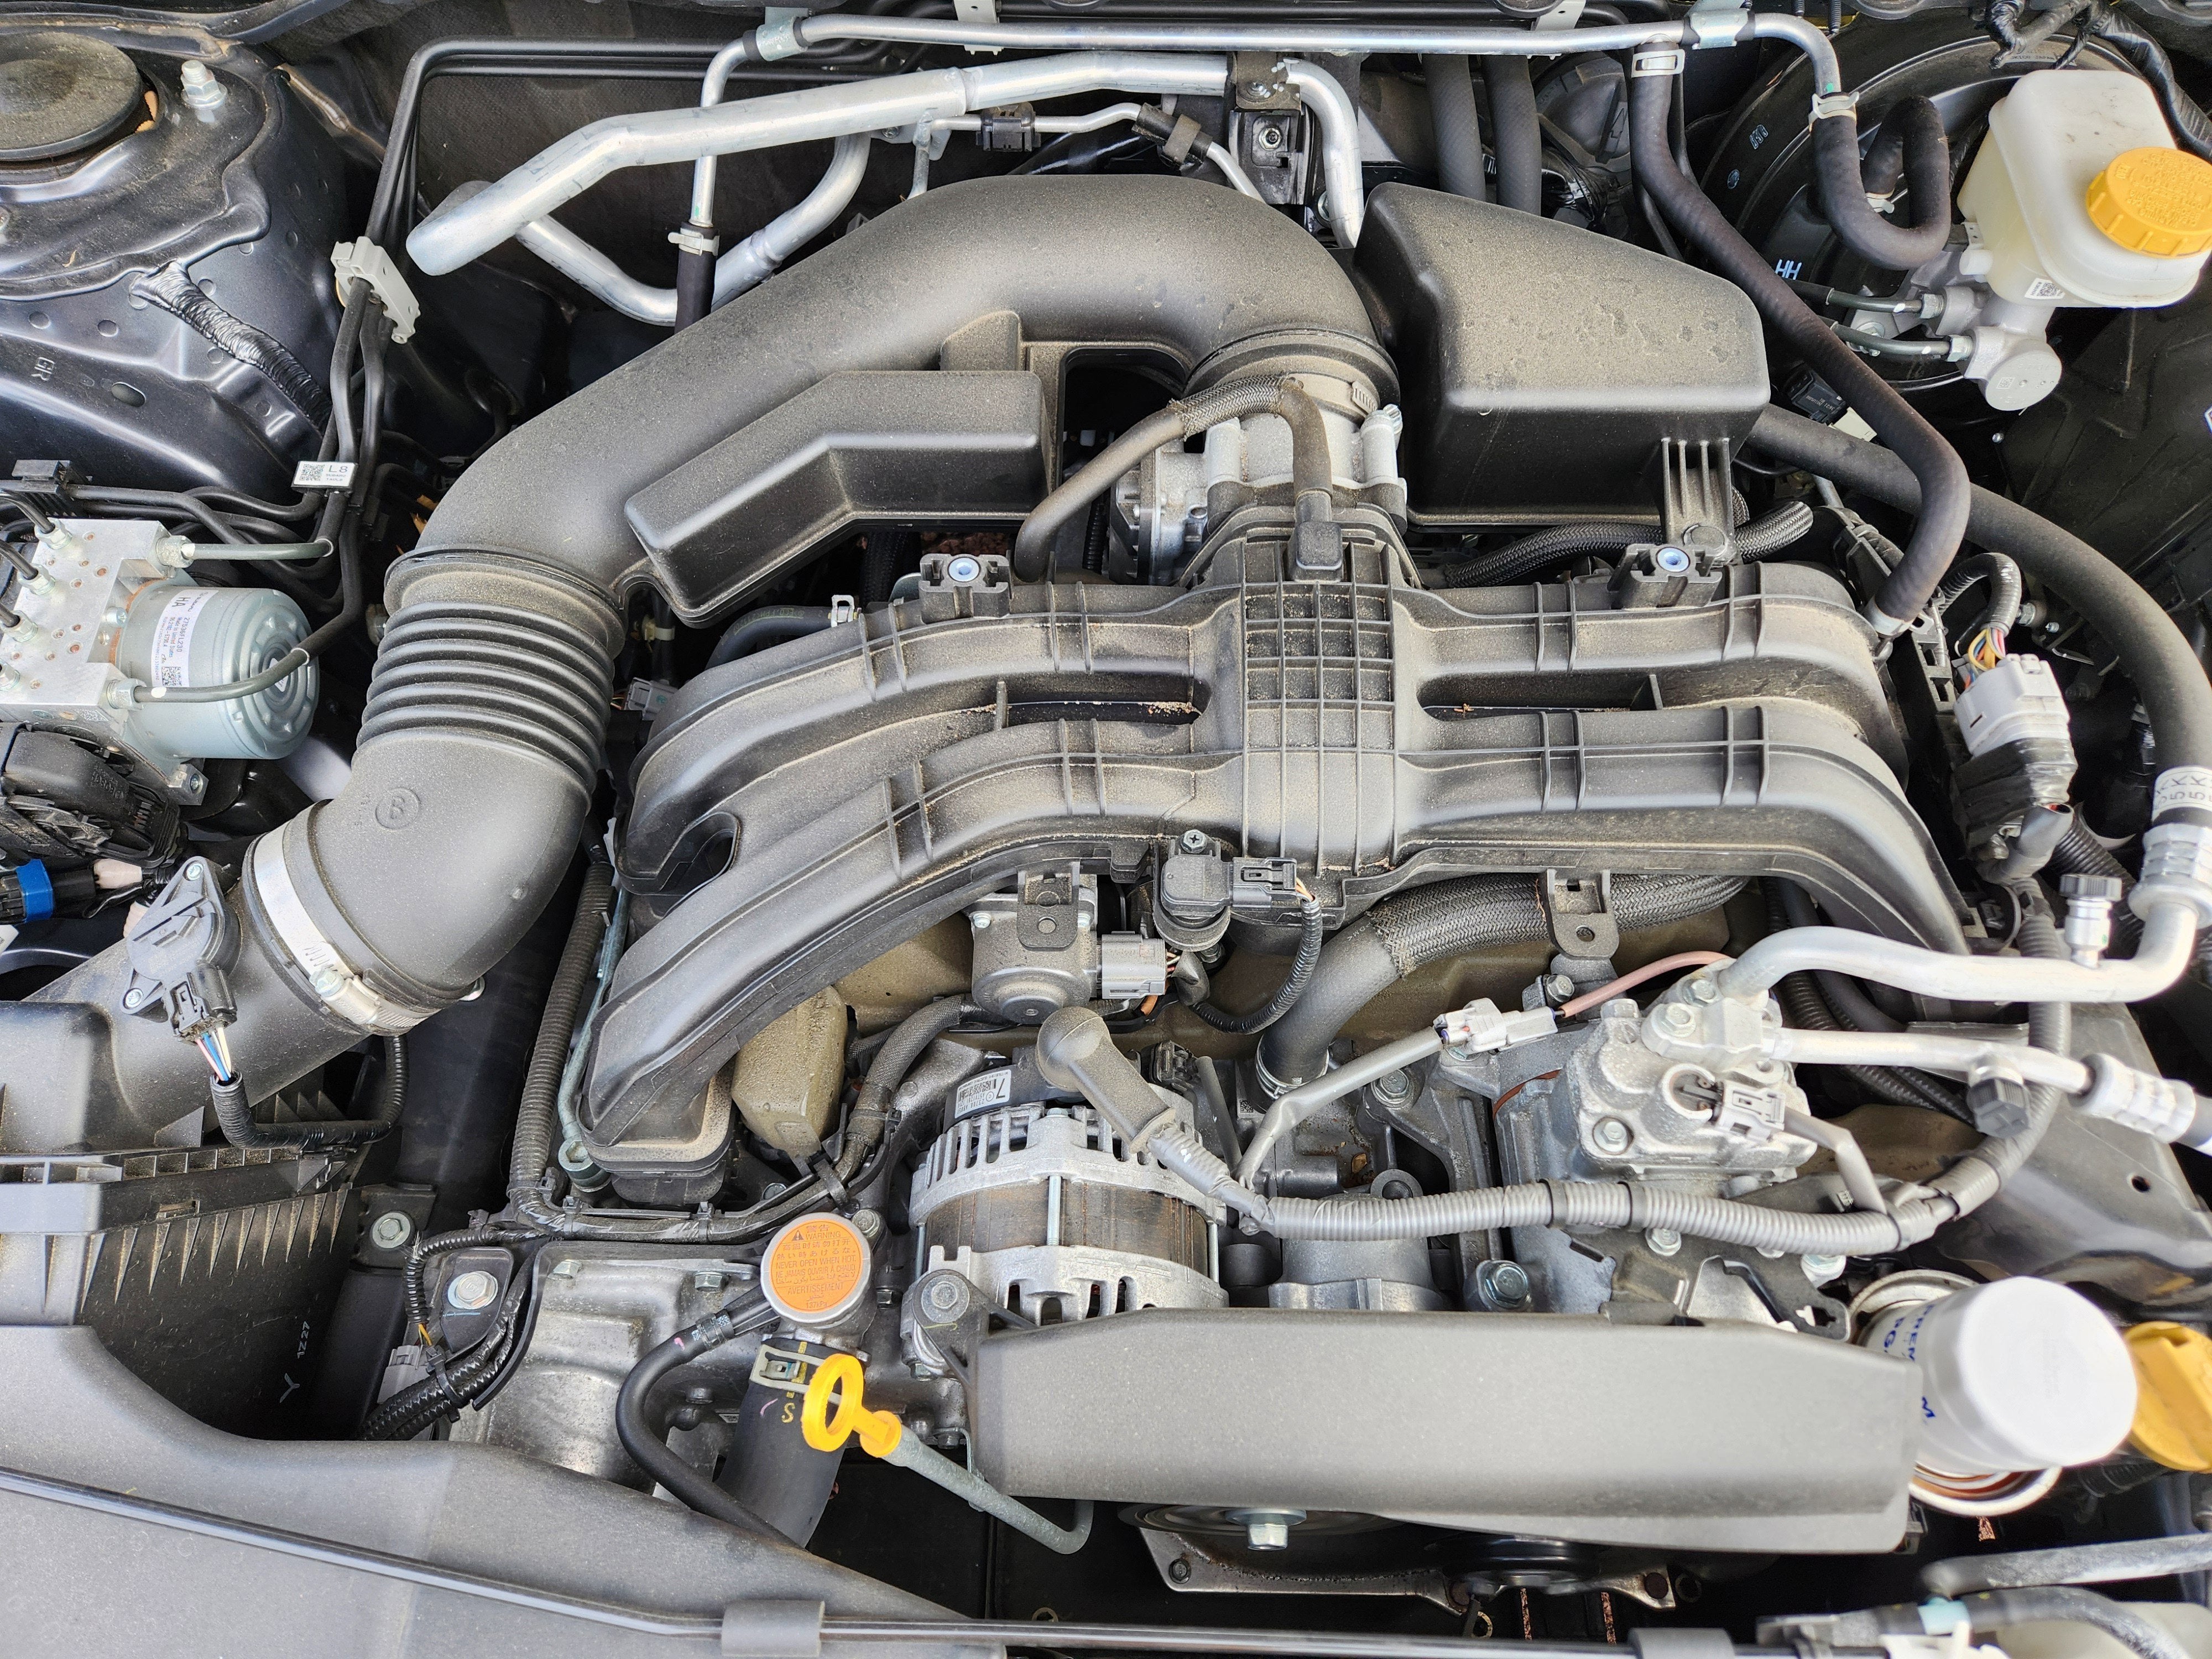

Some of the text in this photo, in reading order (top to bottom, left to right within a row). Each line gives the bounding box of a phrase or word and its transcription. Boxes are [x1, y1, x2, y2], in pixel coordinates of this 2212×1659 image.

[1775, 259, 1802, 280] HH
[172, 597, 191, 607] HA
[996, 1078, 1005, 1099] 7
[806, 1231, 841, 1240] WARNING
[785, 1269, 805, 1277] JAMAIS
[808, 1266, 828, 1275] OUVRIR
[788, 1282, 843, 1295] AVERTISSEMENT
[782, 1402, 795, 1423] S
